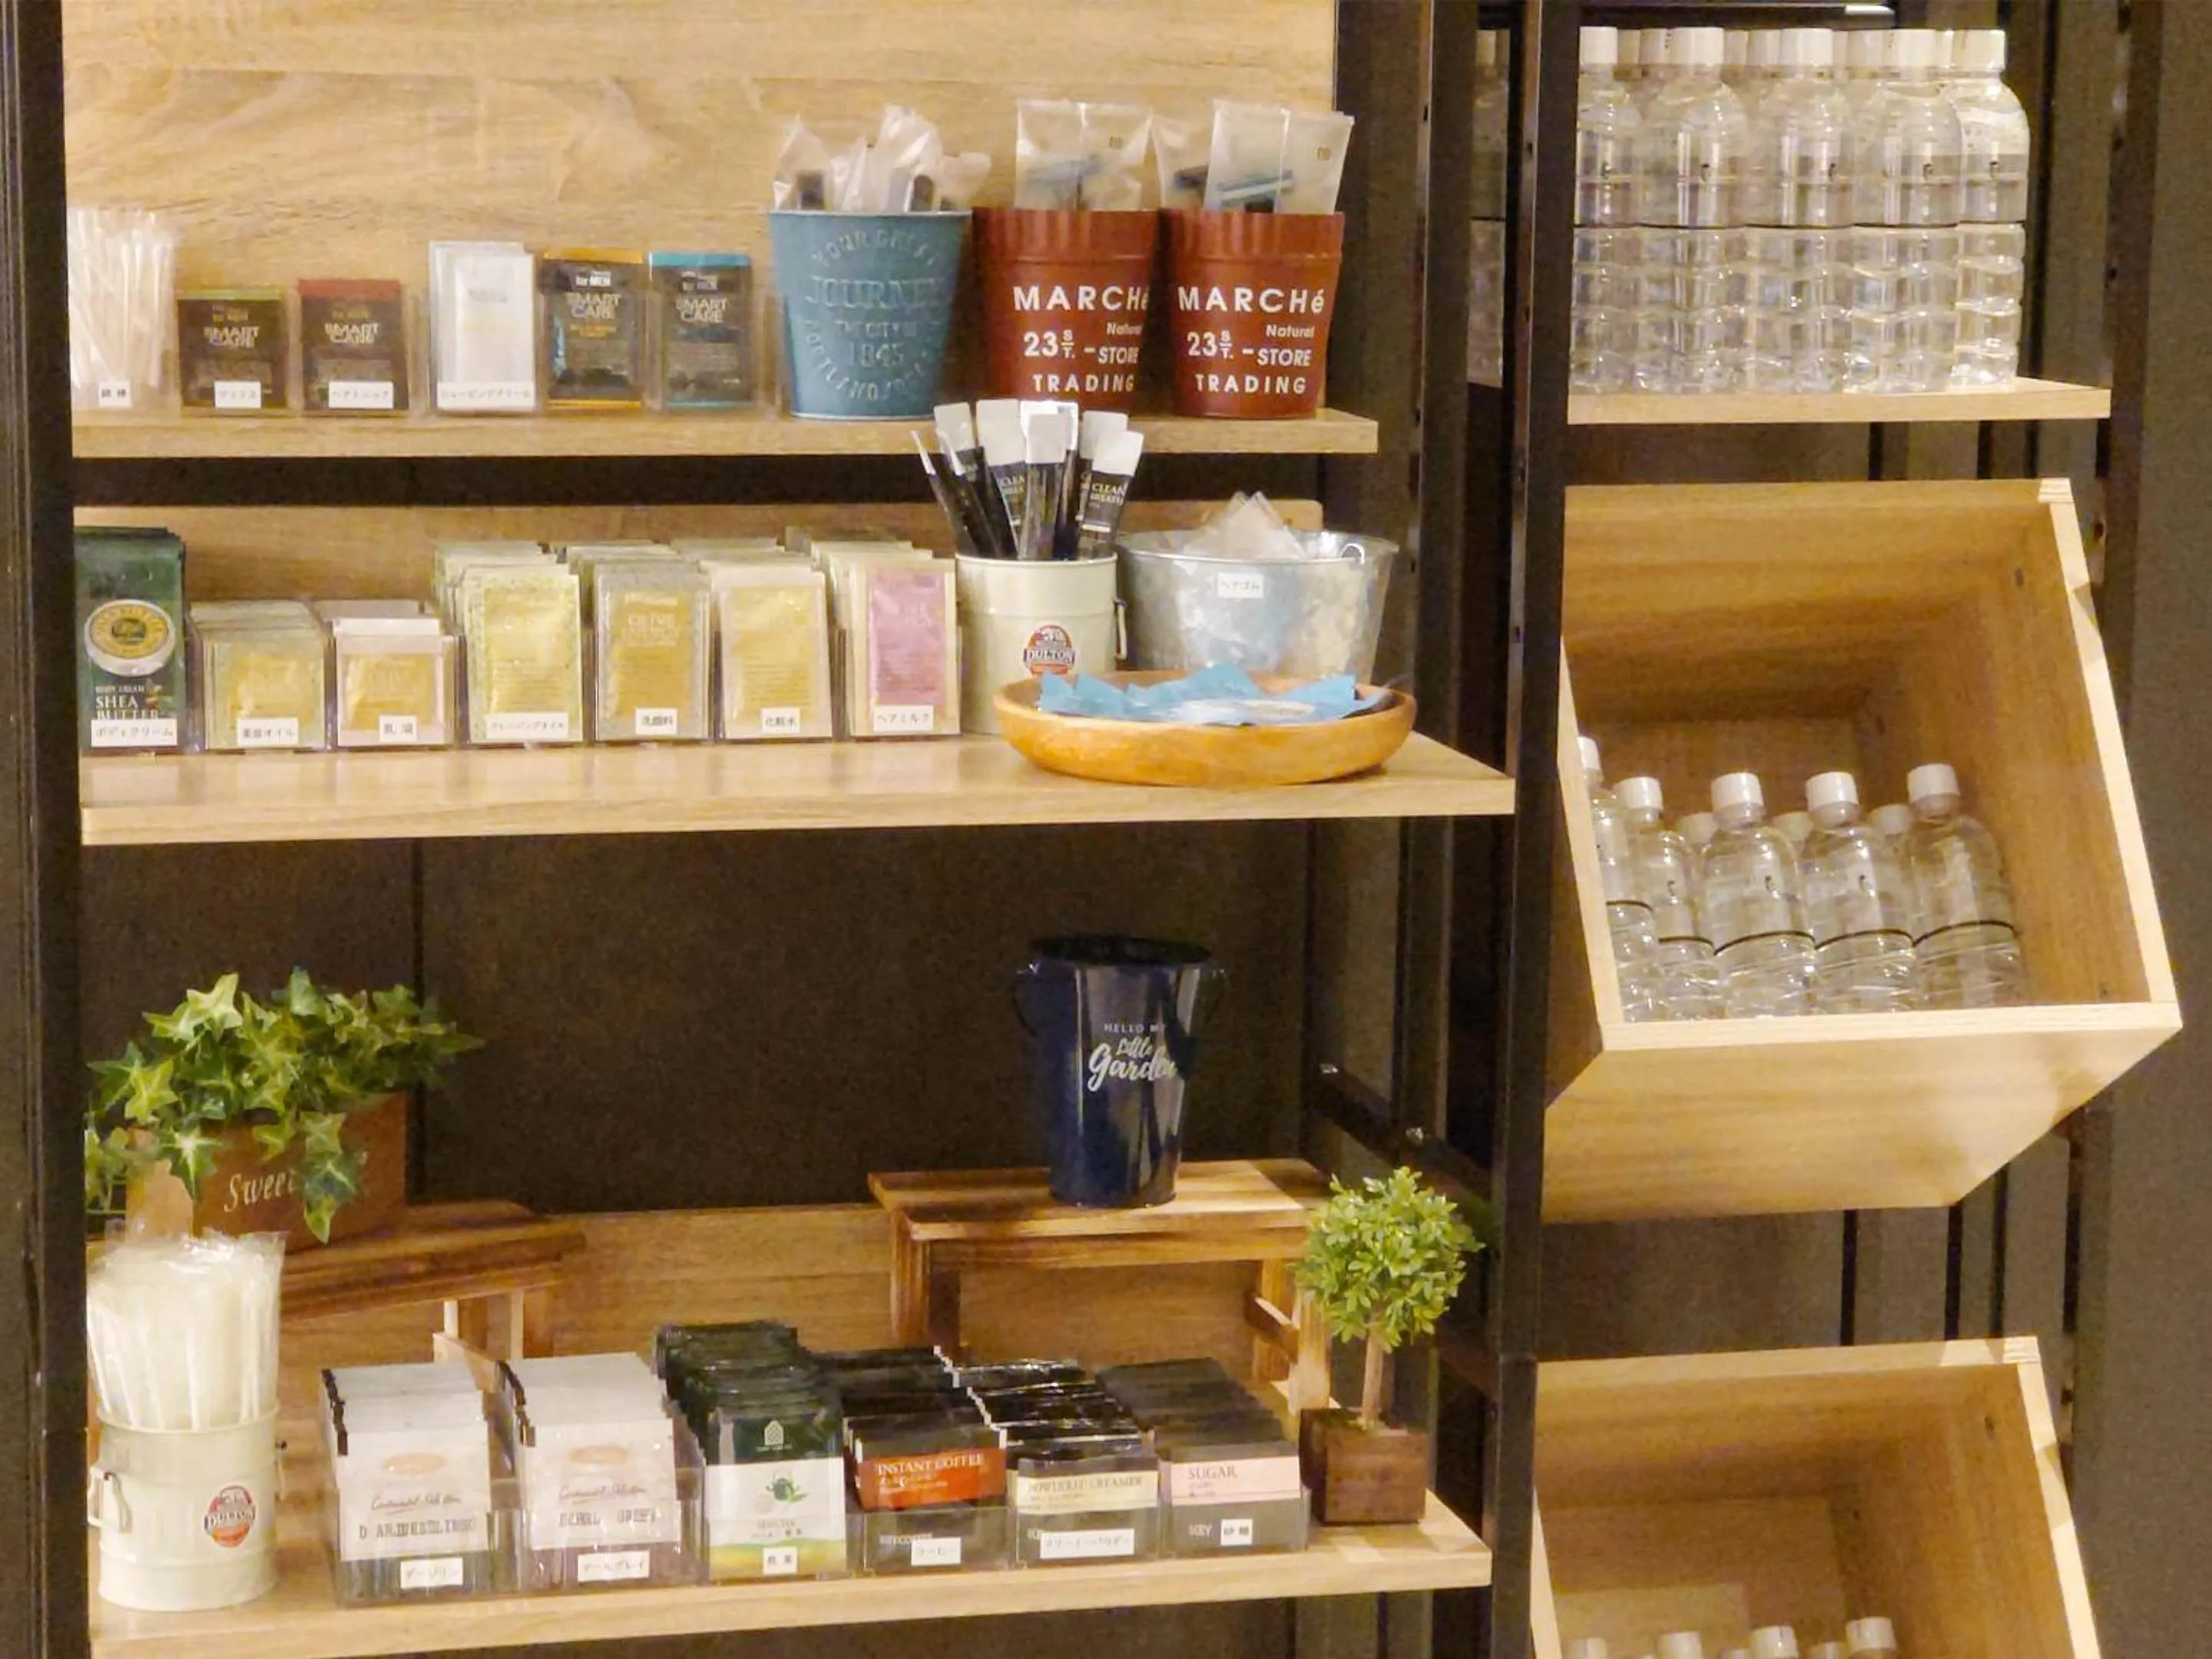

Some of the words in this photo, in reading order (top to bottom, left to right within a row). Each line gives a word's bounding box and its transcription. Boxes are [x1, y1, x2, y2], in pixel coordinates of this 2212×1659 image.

[1177, 286, 1326, 313] MARCHé
[1266, 323, 1315, 339] Natural
[1032, 373, 1134, 392] TRADING
[1195, 373, 1307, 395] TRADING
[95, 694, 139, 709] SHEA
[1104, 1023, 1144, 1032] HELLO
[877, 1461, 931, 1476] INSTANT
[935, 1453, 984, 1469] COFFEE
[1188, 1465, 1237, 1480] SUGAR
